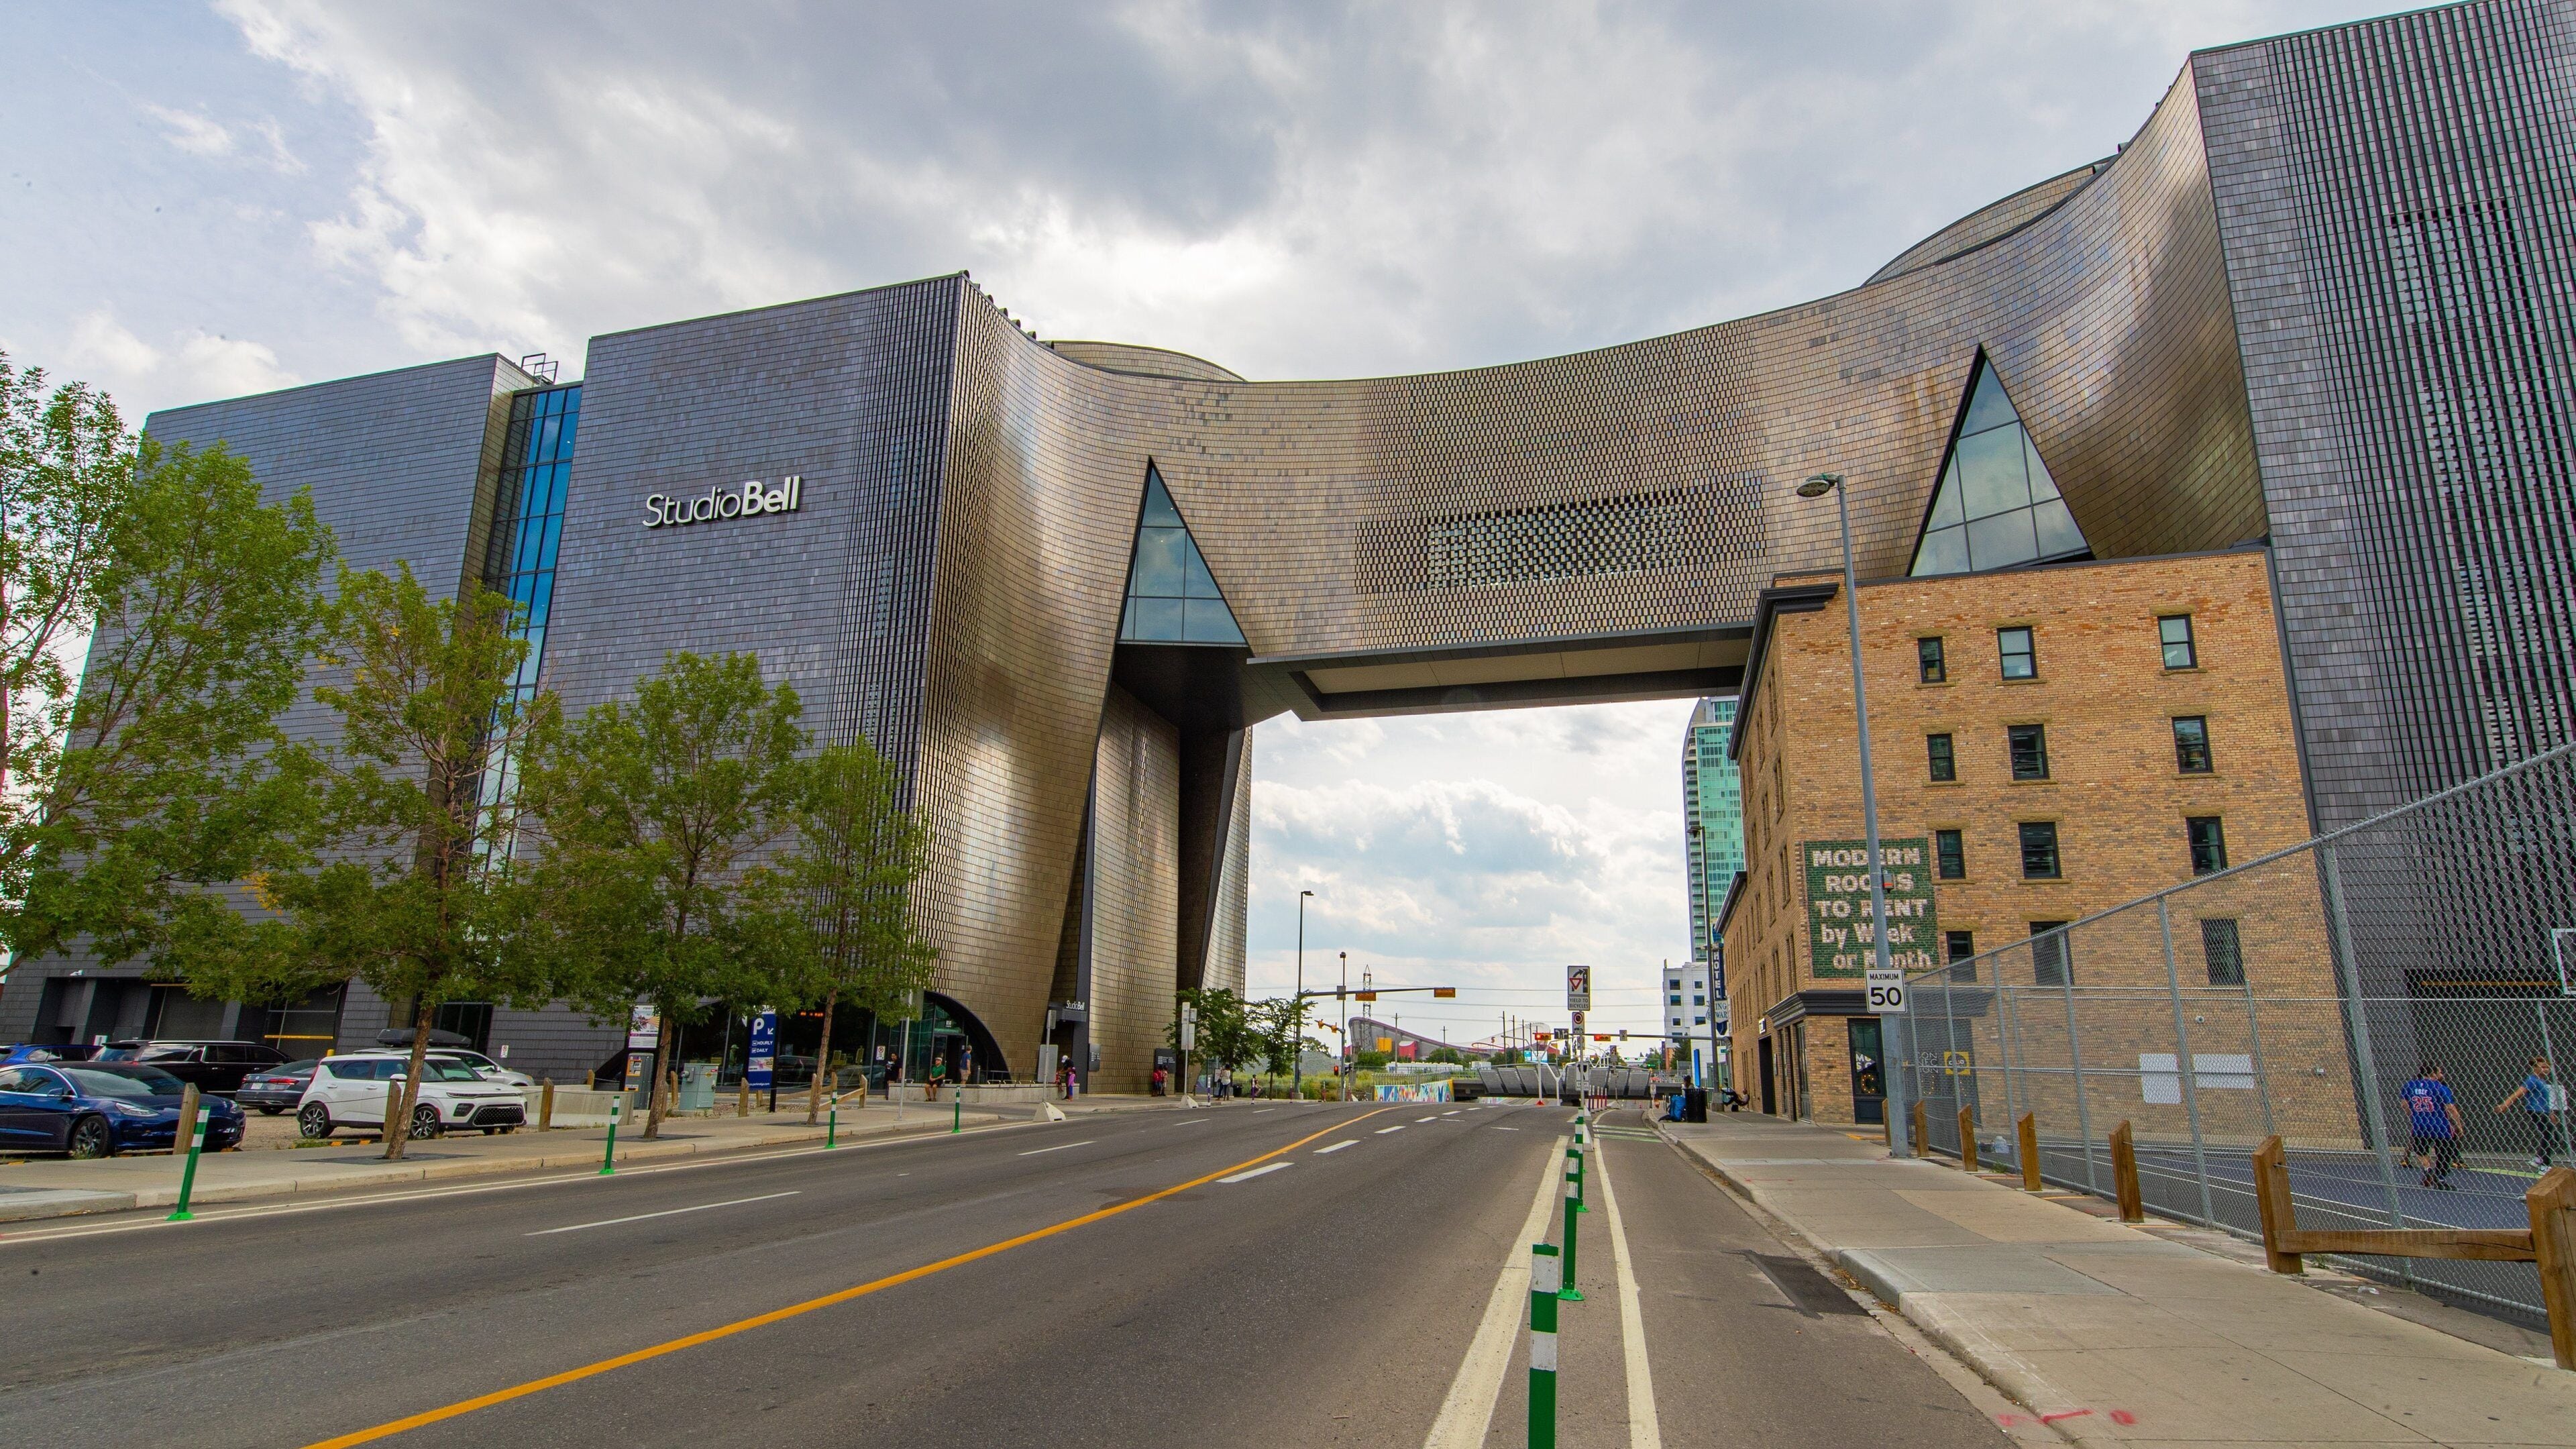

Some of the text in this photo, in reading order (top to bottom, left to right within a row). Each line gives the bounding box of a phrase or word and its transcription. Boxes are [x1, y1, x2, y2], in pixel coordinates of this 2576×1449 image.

[642, 475, 802, 527] StudioBell
[1825, 873, 1914, 892] ROOS
[1815, 900, 1851, 918] TO
[1821, 922, 1915, 950] by Wek
[1833, 949, 1933, 969] or Mnth
[1713, 952, 1721, 998] HOTEL
[1715, 1002, 1727, 1010] ING
[1870, 987, 1902, 1006] 50
[2412, 1095, 2434, 1112] 25
